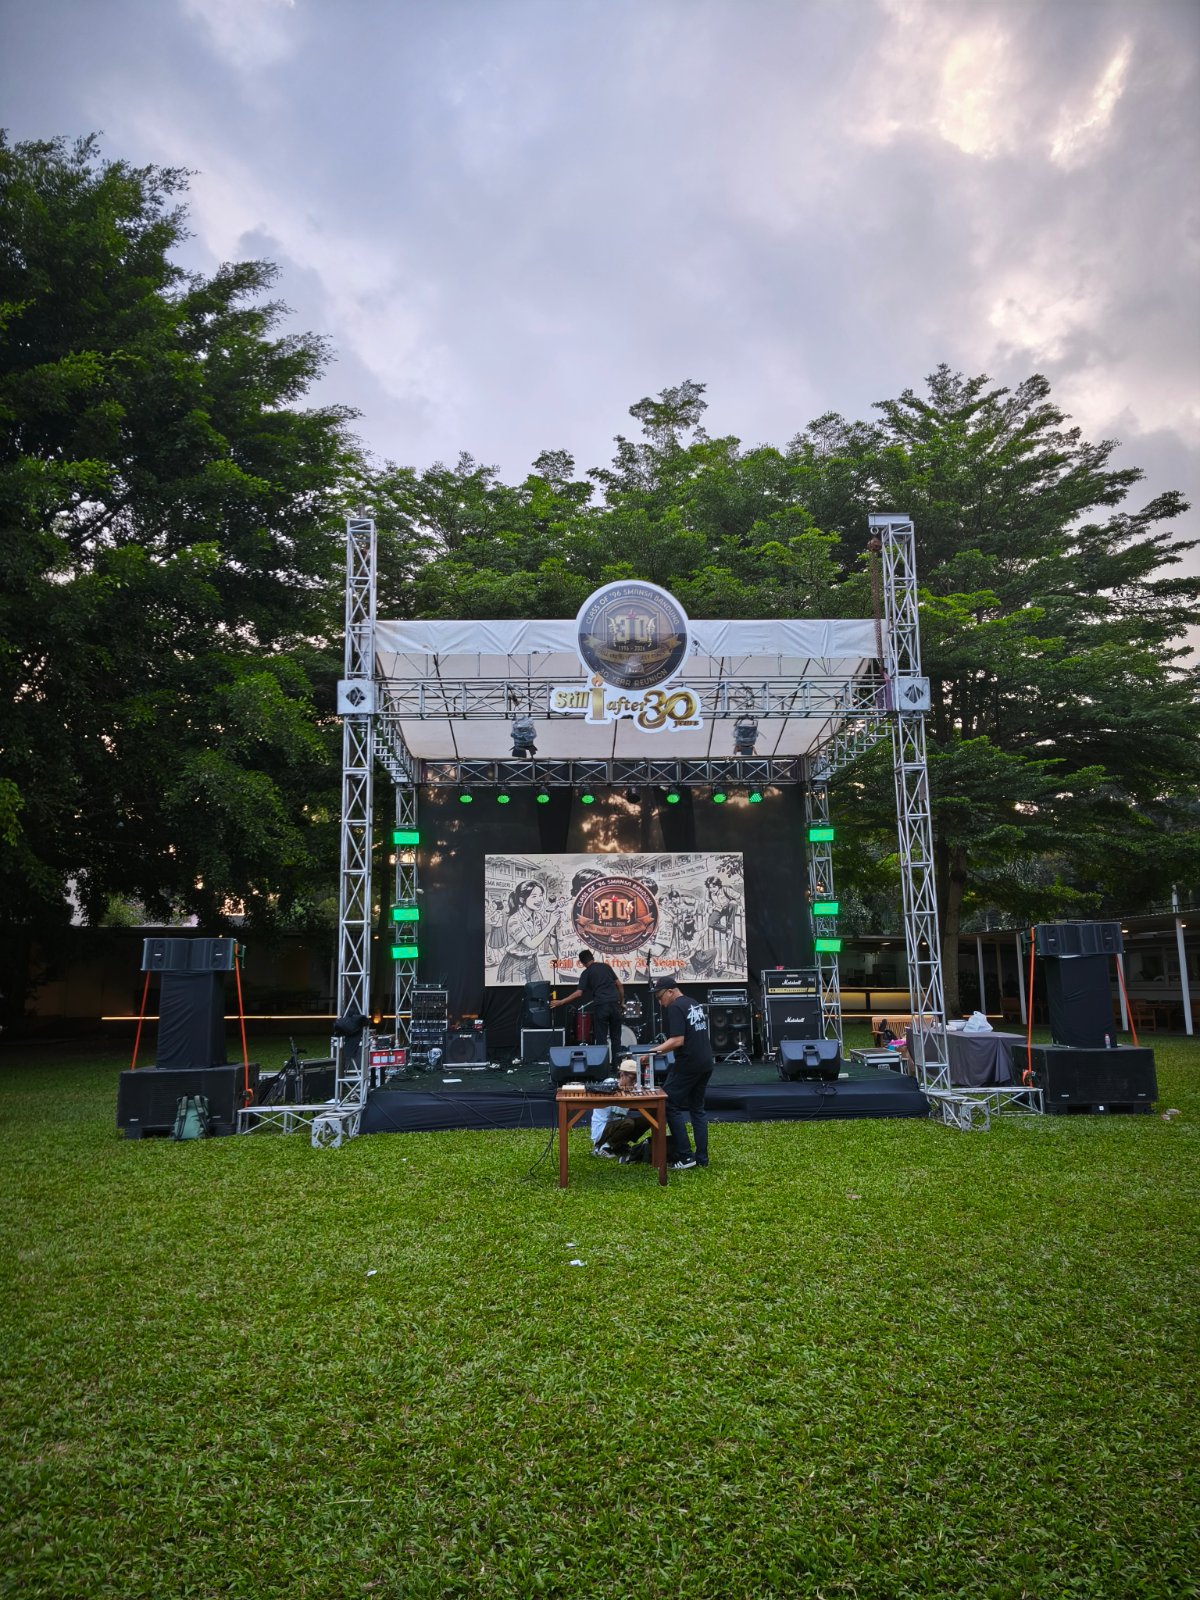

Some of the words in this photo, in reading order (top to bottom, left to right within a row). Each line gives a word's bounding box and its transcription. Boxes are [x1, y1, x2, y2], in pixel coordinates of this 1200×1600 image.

[586, 605, 600, 624] CLASS
[599, 596, 609, 605] OF
[623, 588, 653, 599] SMANSA
[653, 595, 680, 625] BANDUNG
[616, 614, 649, 642] 30
[612, 676, 631, 687] YEAR
[634, 669, 668, 688] REUNION
[555, 691, 589, 709] Still
[606, 696, 648, 715] after
[637, 690, 697, 729] 30
[673, 719, 699, 728] years
[577, 891, 589, 907] CLASS
[588, 884, 596, 893] OF
[607, 879, 632, 887] SMANSA
[632, 882, 654, 907] BANDUNG
[601, 899, 629, 920] 30
[598, 944, 614, 952] YEAR
